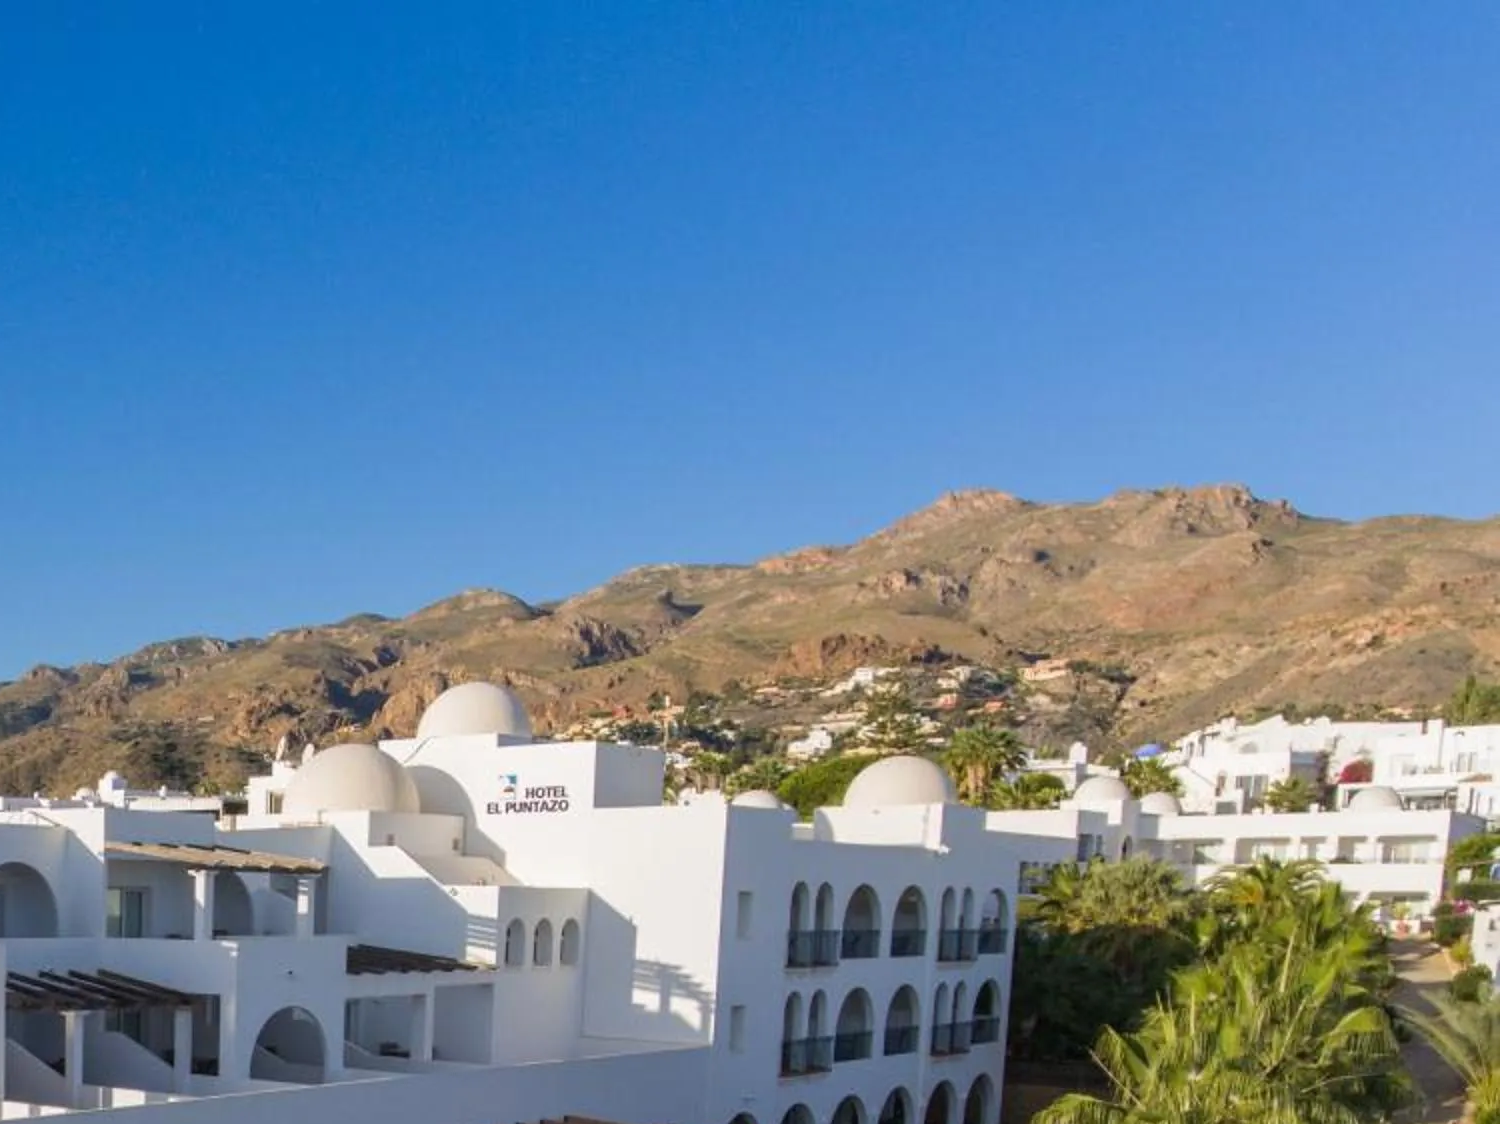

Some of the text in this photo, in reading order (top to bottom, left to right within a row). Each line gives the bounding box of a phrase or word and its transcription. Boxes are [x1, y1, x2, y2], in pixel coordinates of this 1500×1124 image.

[525, 786, 568, 799] HOTEL
[487, 799, 569, 815] EL PUNTAZO
